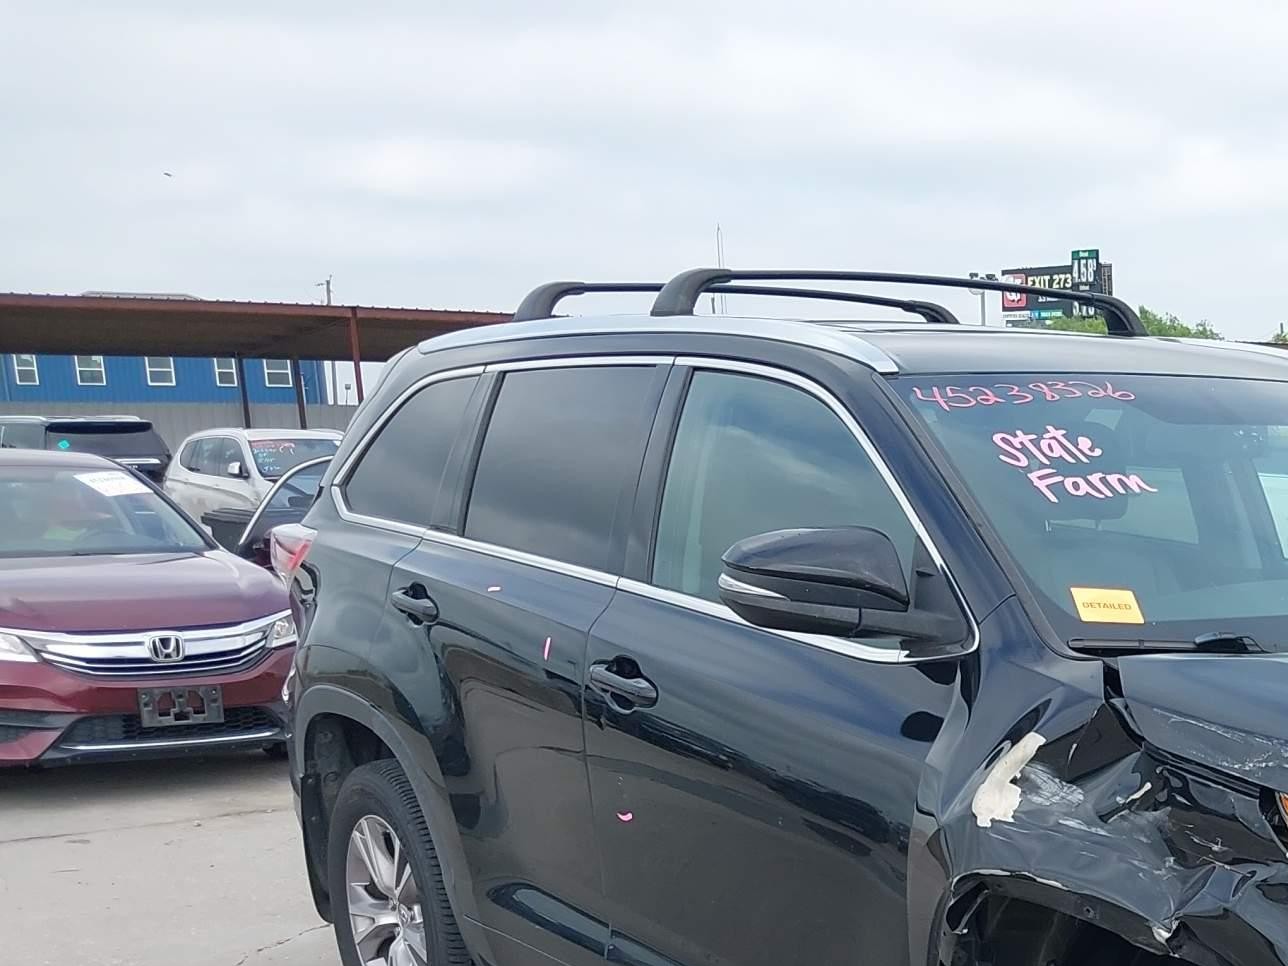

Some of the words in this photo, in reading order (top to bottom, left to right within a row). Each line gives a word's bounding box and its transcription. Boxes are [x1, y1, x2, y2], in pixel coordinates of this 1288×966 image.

[1028, 275, 1050, 288] EXIT
[1052, 273, 1072, 289] 273
[912, 380, 1136, 412] 45238326
[992, 425, 1102, 468] State
[1027, 469, 1159, 504] Farm
[1082, 600, 1133, 612] DETAILED
